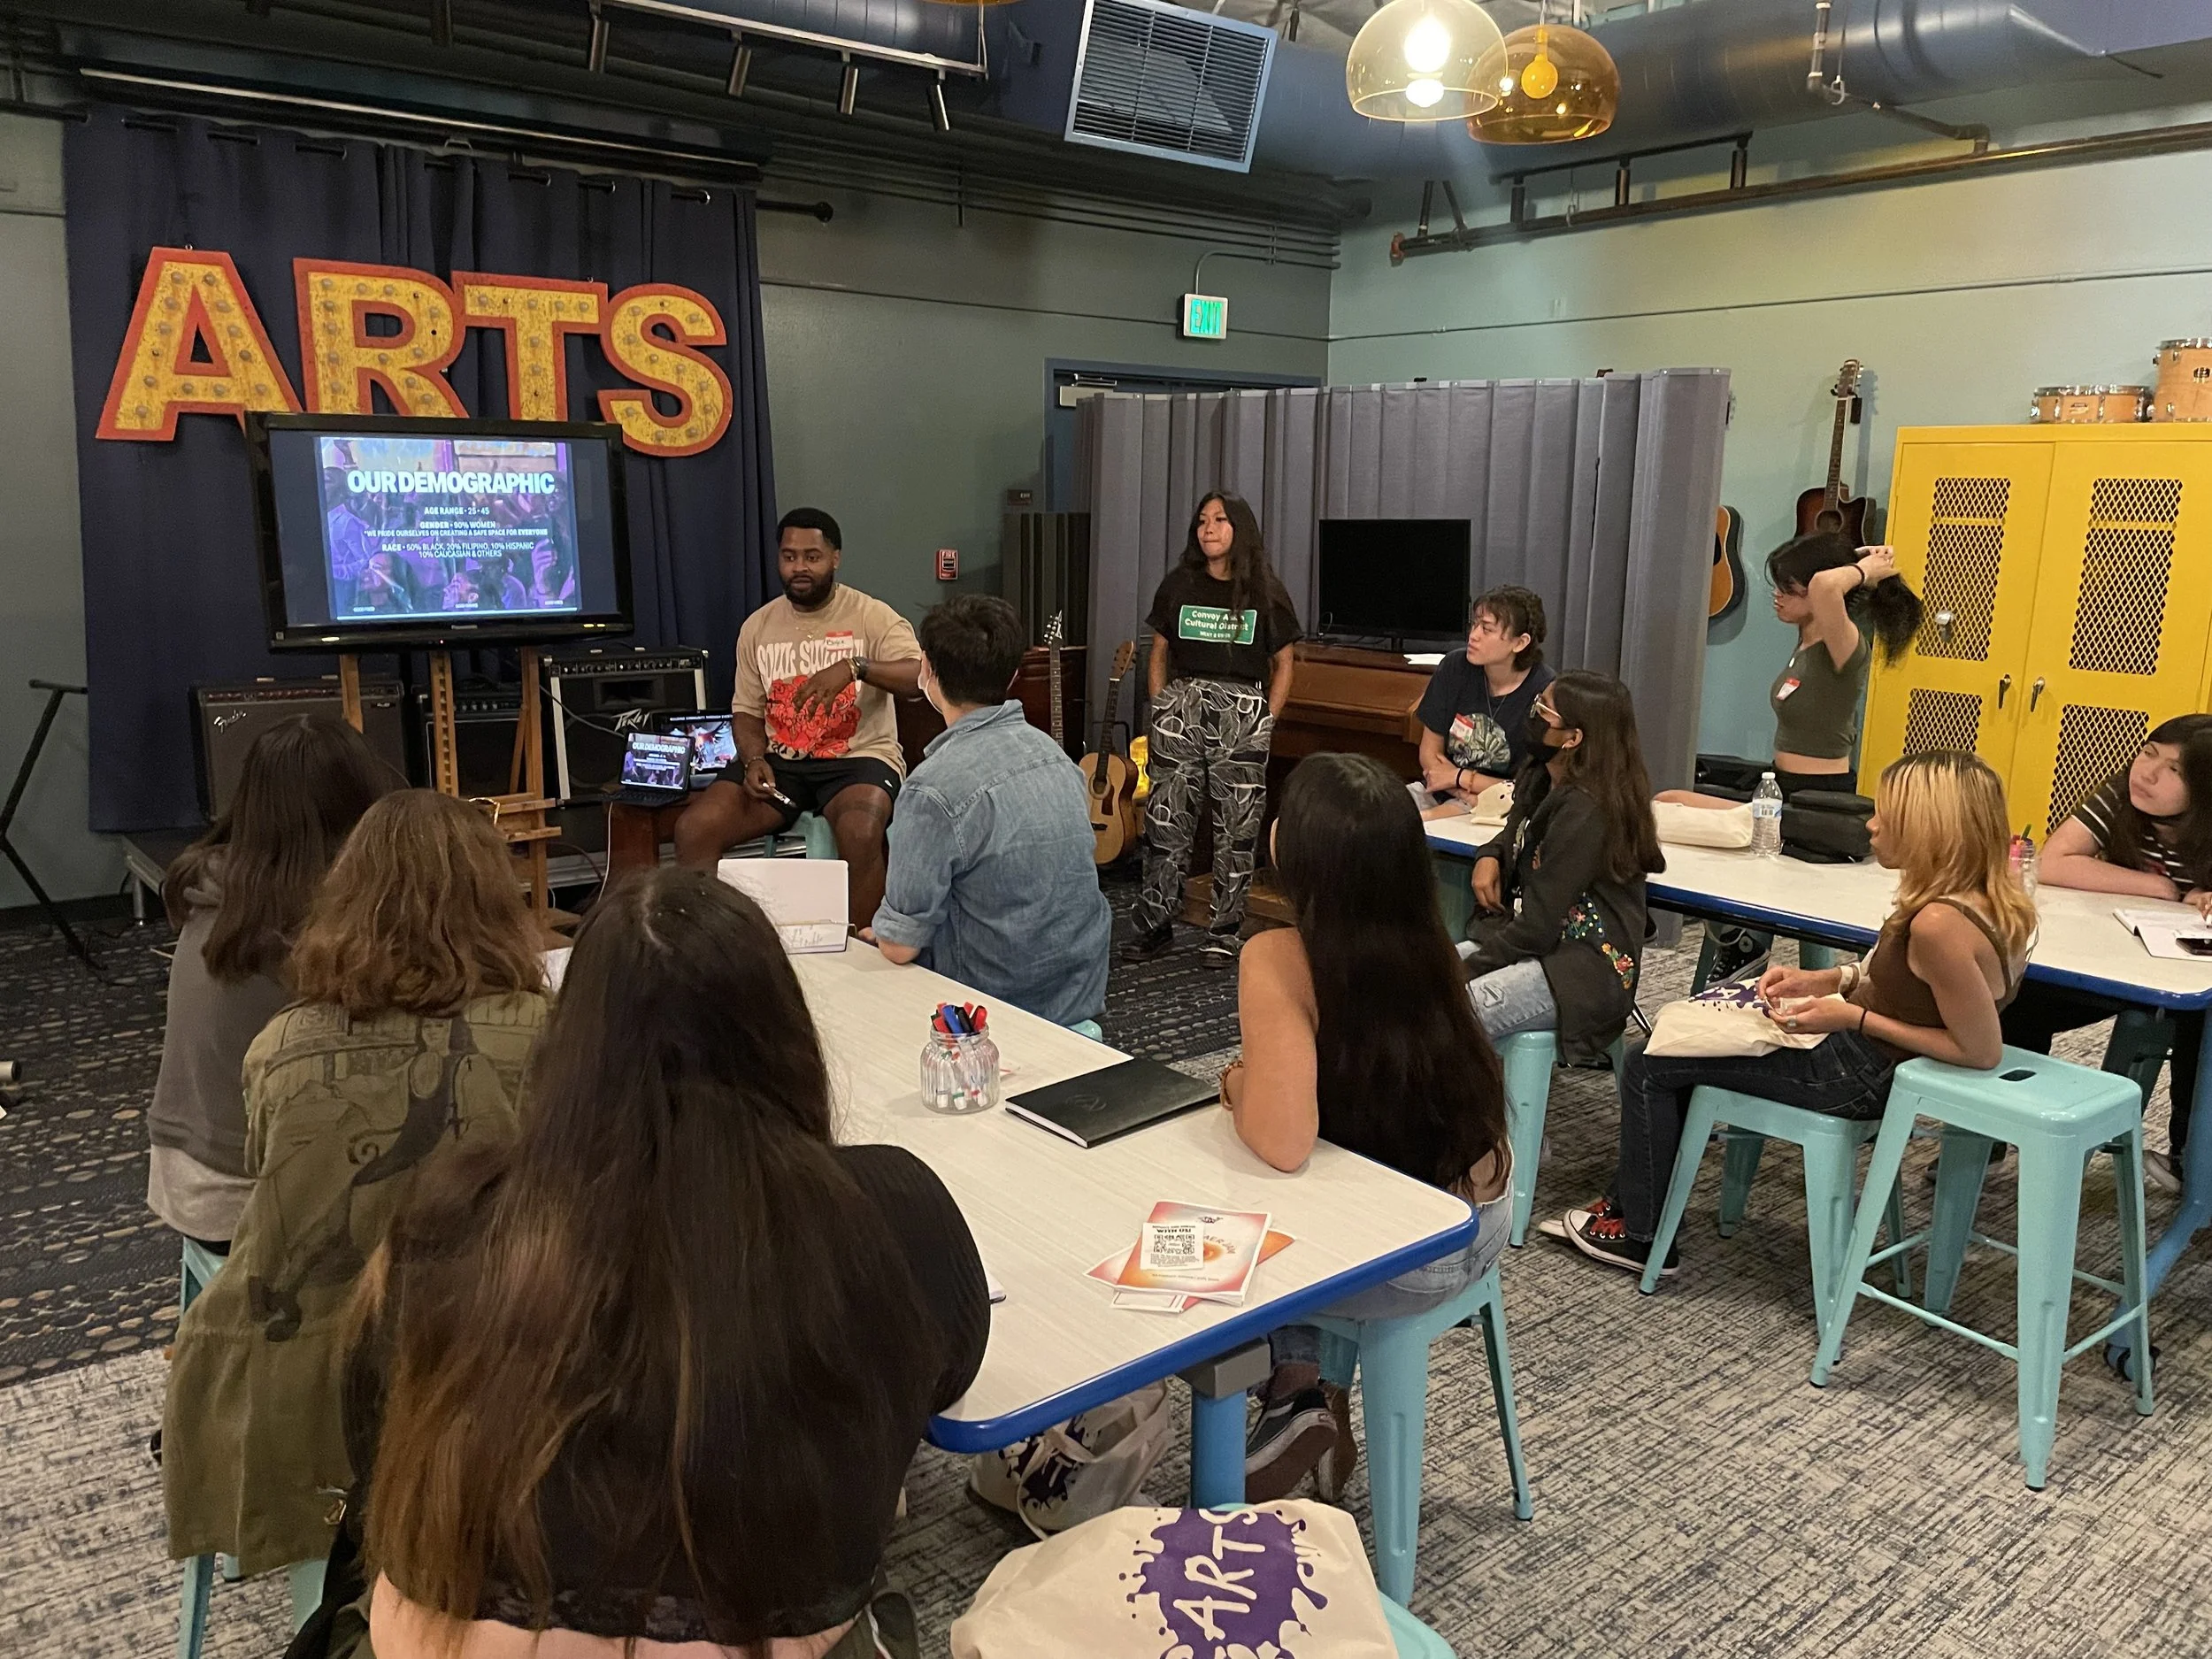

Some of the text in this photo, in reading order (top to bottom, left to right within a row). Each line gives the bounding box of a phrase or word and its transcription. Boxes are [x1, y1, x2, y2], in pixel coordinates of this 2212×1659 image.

[1190, 299, 1223, 335] EXIT
[96, 246, 733, 457] ARTS
[347, 470, 555, 495] OUR DEMOGRAPHIC
[424, 506, 439, 515] AGE
[440, 506, 464, 515] RANGE
[480, 506, 490, 515] 45
[1191, 610, 1221, 622] Convoy
[1184, 618, 1248, 631] Cultural Distrct
[632, 741, 686, 755] OUR DEMOGRAPHIC
